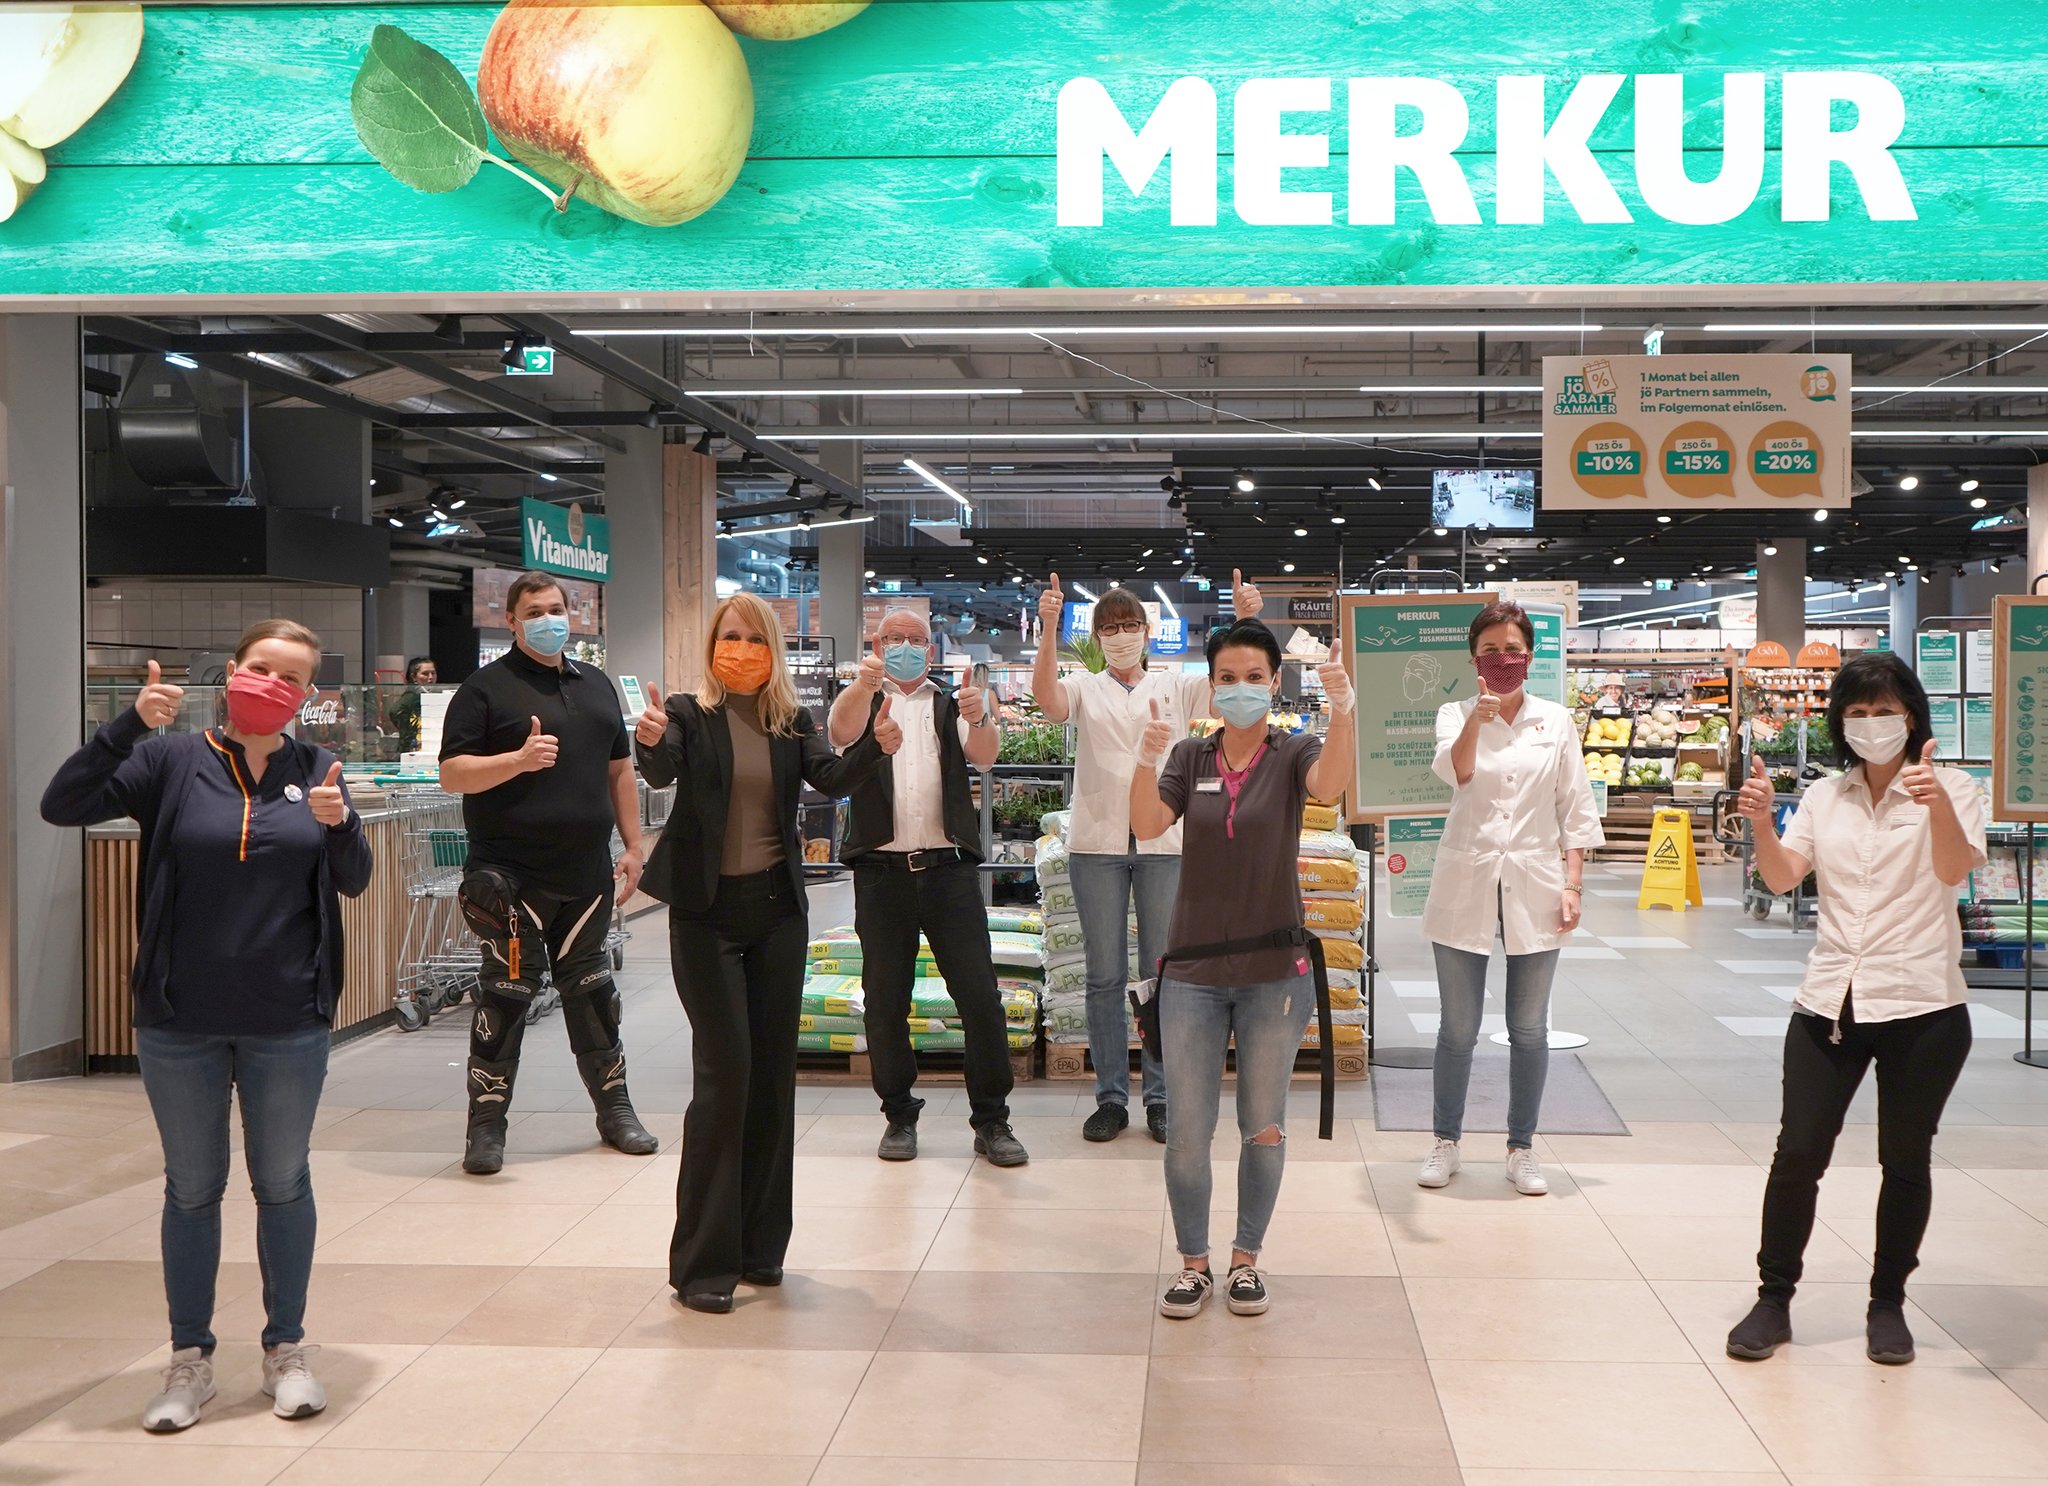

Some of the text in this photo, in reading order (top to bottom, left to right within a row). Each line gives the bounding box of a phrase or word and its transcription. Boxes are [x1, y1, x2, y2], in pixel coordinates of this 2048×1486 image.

[1057, 71, 1919, 226] MERKUR
[1640, 371, 1740, 382] 1 Monat bei allen
[1566, 378, 1584, 396] jö
[1640, 387, 1772, 399] jö Partnern sammeln,
[1558, 393, 1614, 404] RABATT
[1554, 404, 1616, 414] SAMMLER
[1640, 401, 1787, 414] im Folgemonat einlösen.
[1594, 440, 1623, 450] 125 Ös
[1682, 439, 1712, 450] 250 Ös
[1771, 439, 1803, 449] 400 Ös
[1584, 456, 1634, 471] -10%
[1674, 455, 1722, 470] -15%
[1760, 455, 1812, 470] -20%
[528, 517, 609, 574] Vitaminbar
[1293, 601, 1332, 611] KRÄUTE
[1312, 610, 1332, 618] GEERNTE
[1397, 611, 1440, 620] MERKUR
[1419, 626, 1470, 634] ZUSAMMENHALT
[1157, 634, 1181, 642] PREIS
[1419, 634, 1469, 643] ZUSAMMENHELF
[1415, 710, 1438, 718] TRAGE
[1386, 727, 1436, 735] NASEN-MUND-
[1398, 741, 1432, 750] SCHÜTZEN
[1298, 872, 1321, 882] erde
[1057, 1060, 1075, 1070] EPAL
[1340, 1060, 1358, 1070] EPAL
